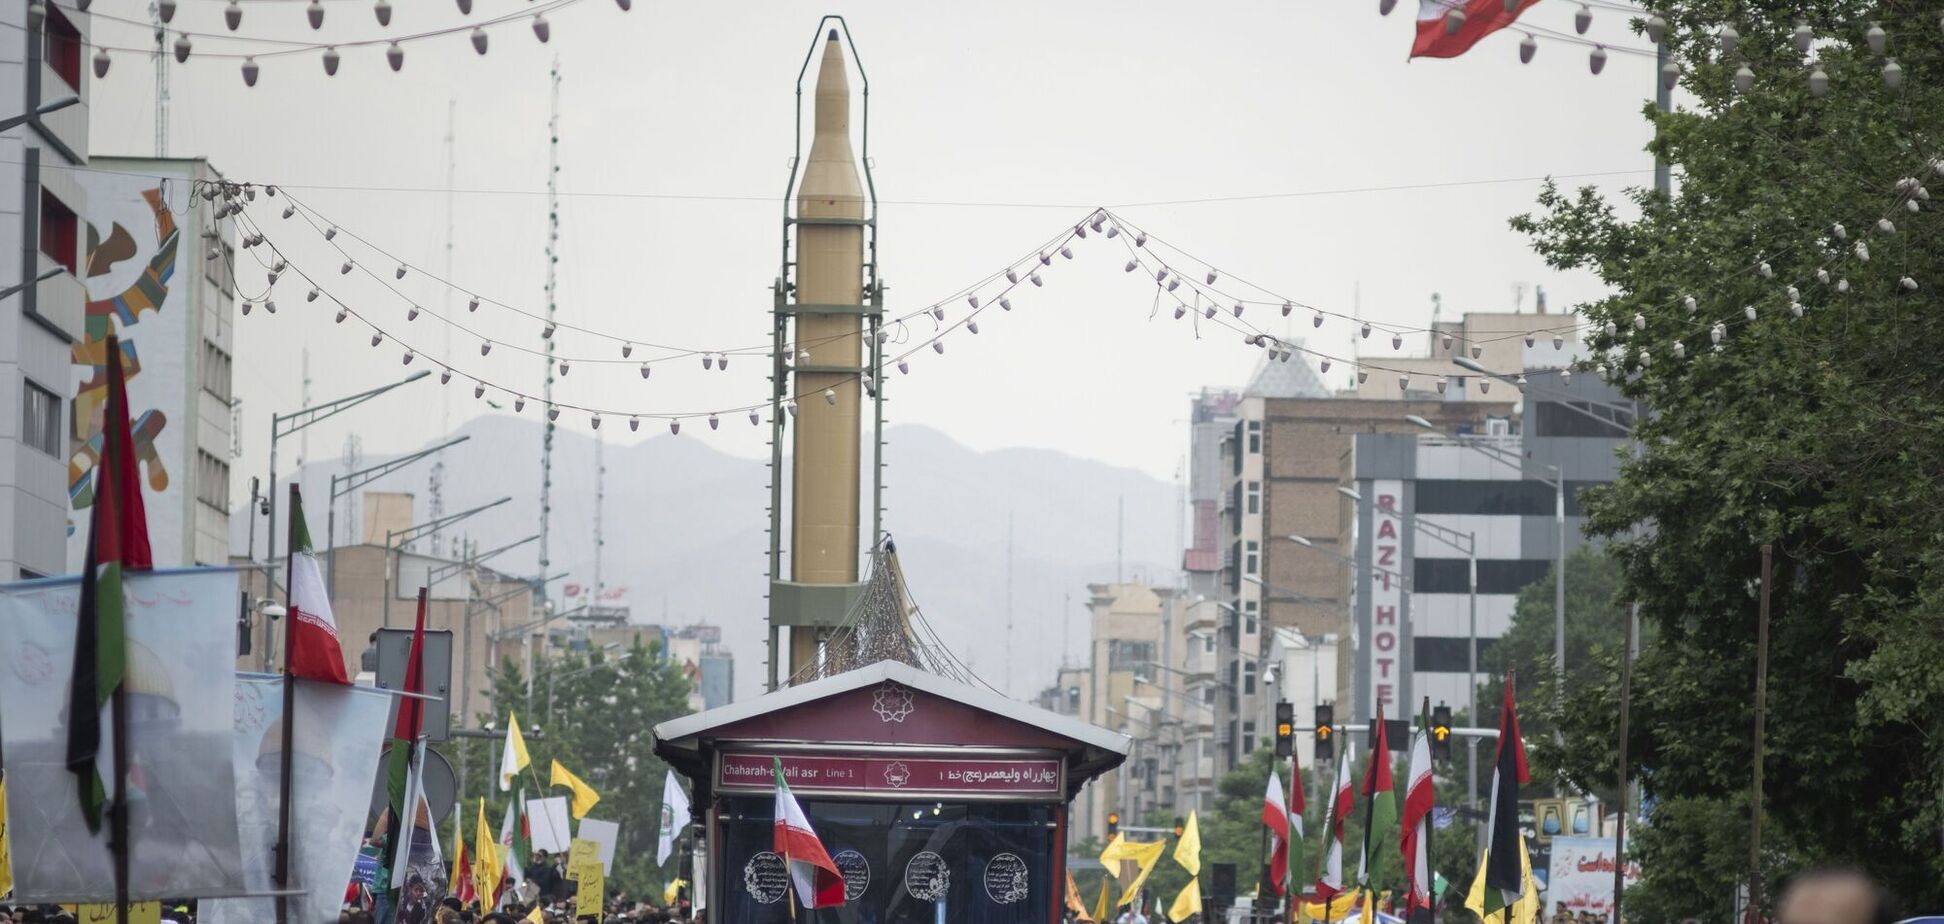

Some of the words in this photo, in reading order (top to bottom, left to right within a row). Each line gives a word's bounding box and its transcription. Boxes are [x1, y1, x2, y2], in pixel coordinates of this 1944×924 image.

[1377, 495, 1397, 591] RAZI
[1376, 606, 1395, 704] HOTE
[724, 764, 774, 777] Chaharah-e
[801, 768, 818, 778] asr
[826, 768, 845, 778] Line
[848, 769, 853, 778] 1
